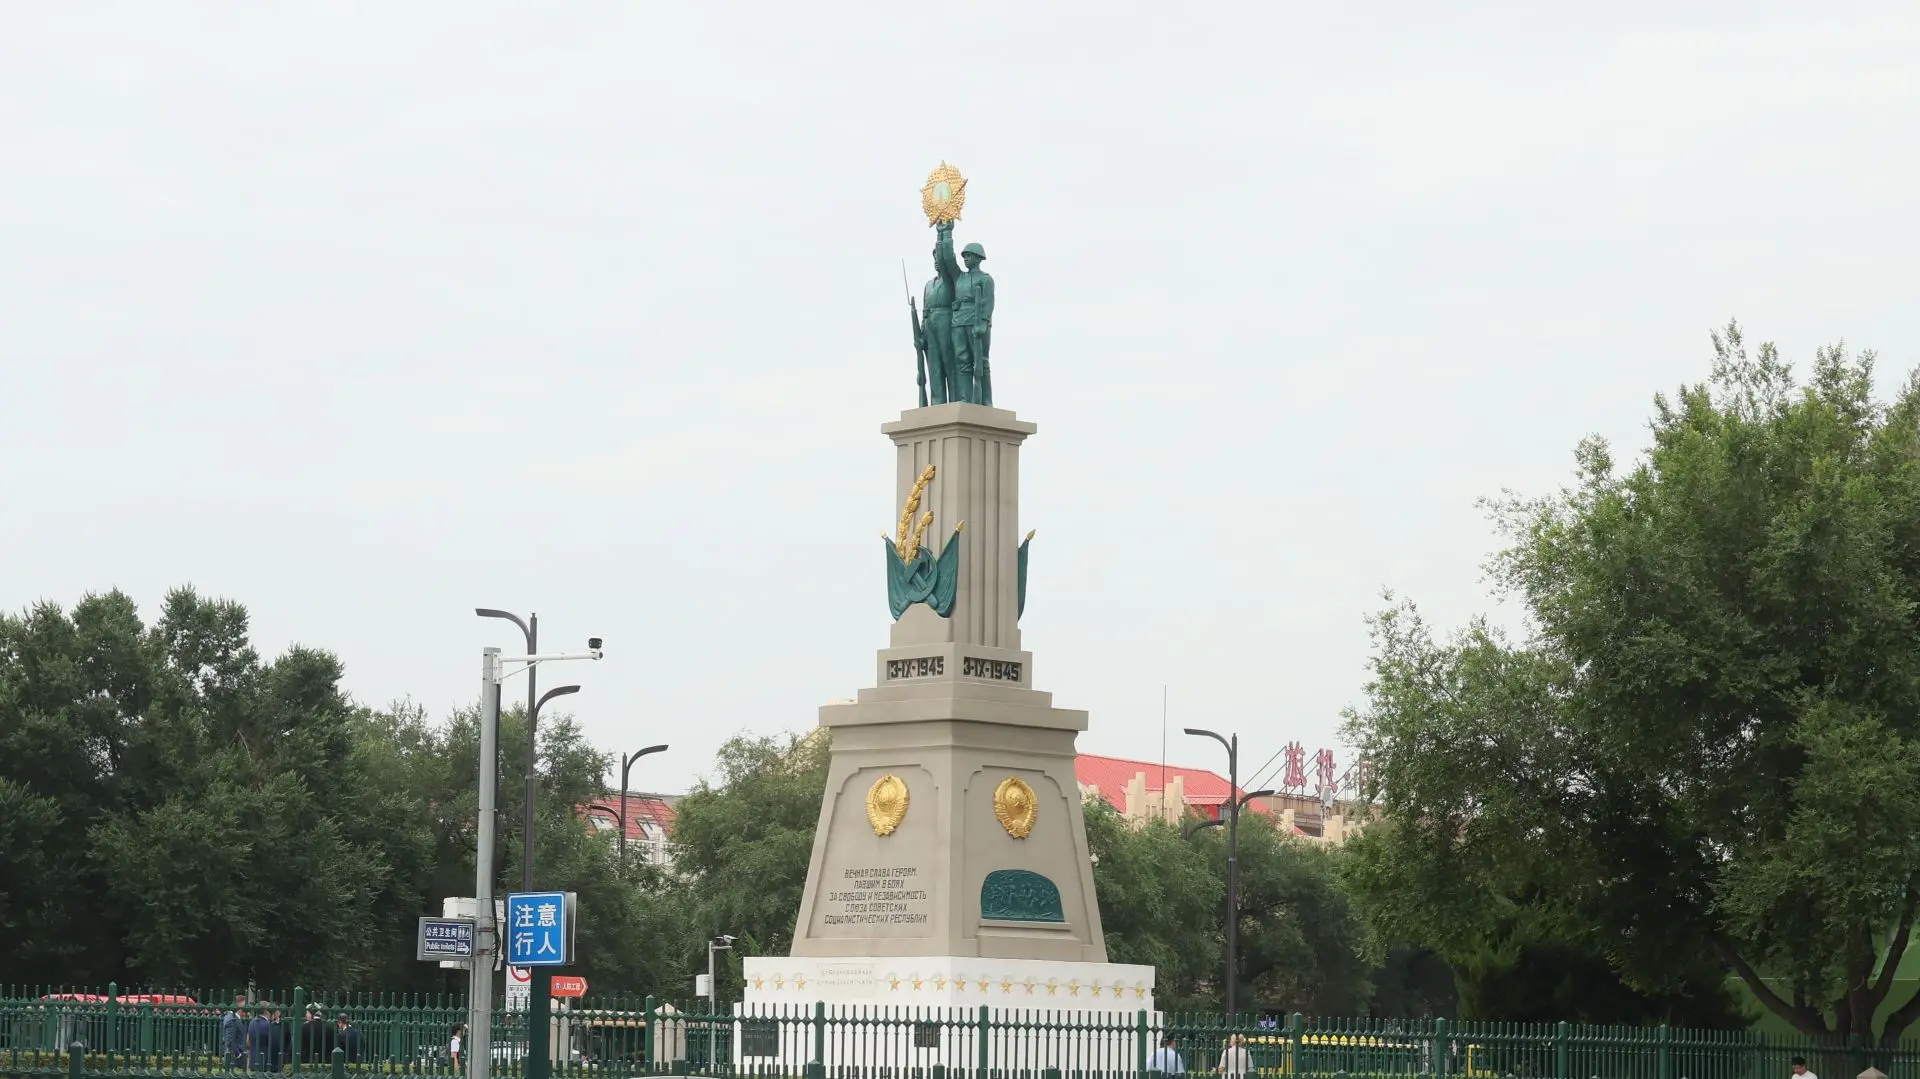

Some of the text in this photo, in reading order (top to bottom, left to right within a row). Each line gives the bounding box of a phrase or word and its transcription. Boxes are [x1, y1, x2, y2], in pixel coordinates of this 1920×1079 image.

[890, 656, 944, 678] 3-IX-1945
[963, 657, 1019, 682] 3-IX-1945
[844, 868, 869, 879] ВЕЧНАЯ
[869, 868, 891, 878] СЛАВА
[881, 880, 886, 889] В
[887, 879, 905, 889] БОЯХ
[829, 890, 927, 901] ЗА СВОБОДУ И НЕЗАВИСИМОСТЬ
[845, 903, 908, 913] СОЮЗА СОВЕТСКИХ
[515, 903, 557, 928] 注意
[824, 914, 928, 925] СОЦИАЛИСТИЧЕСКИХ РЕСПУБЛИК
[425, 926, 457, 938] 公共卫生间
[426, 941, 440, 950] Public
[515, 932, 557, 956] 行人
